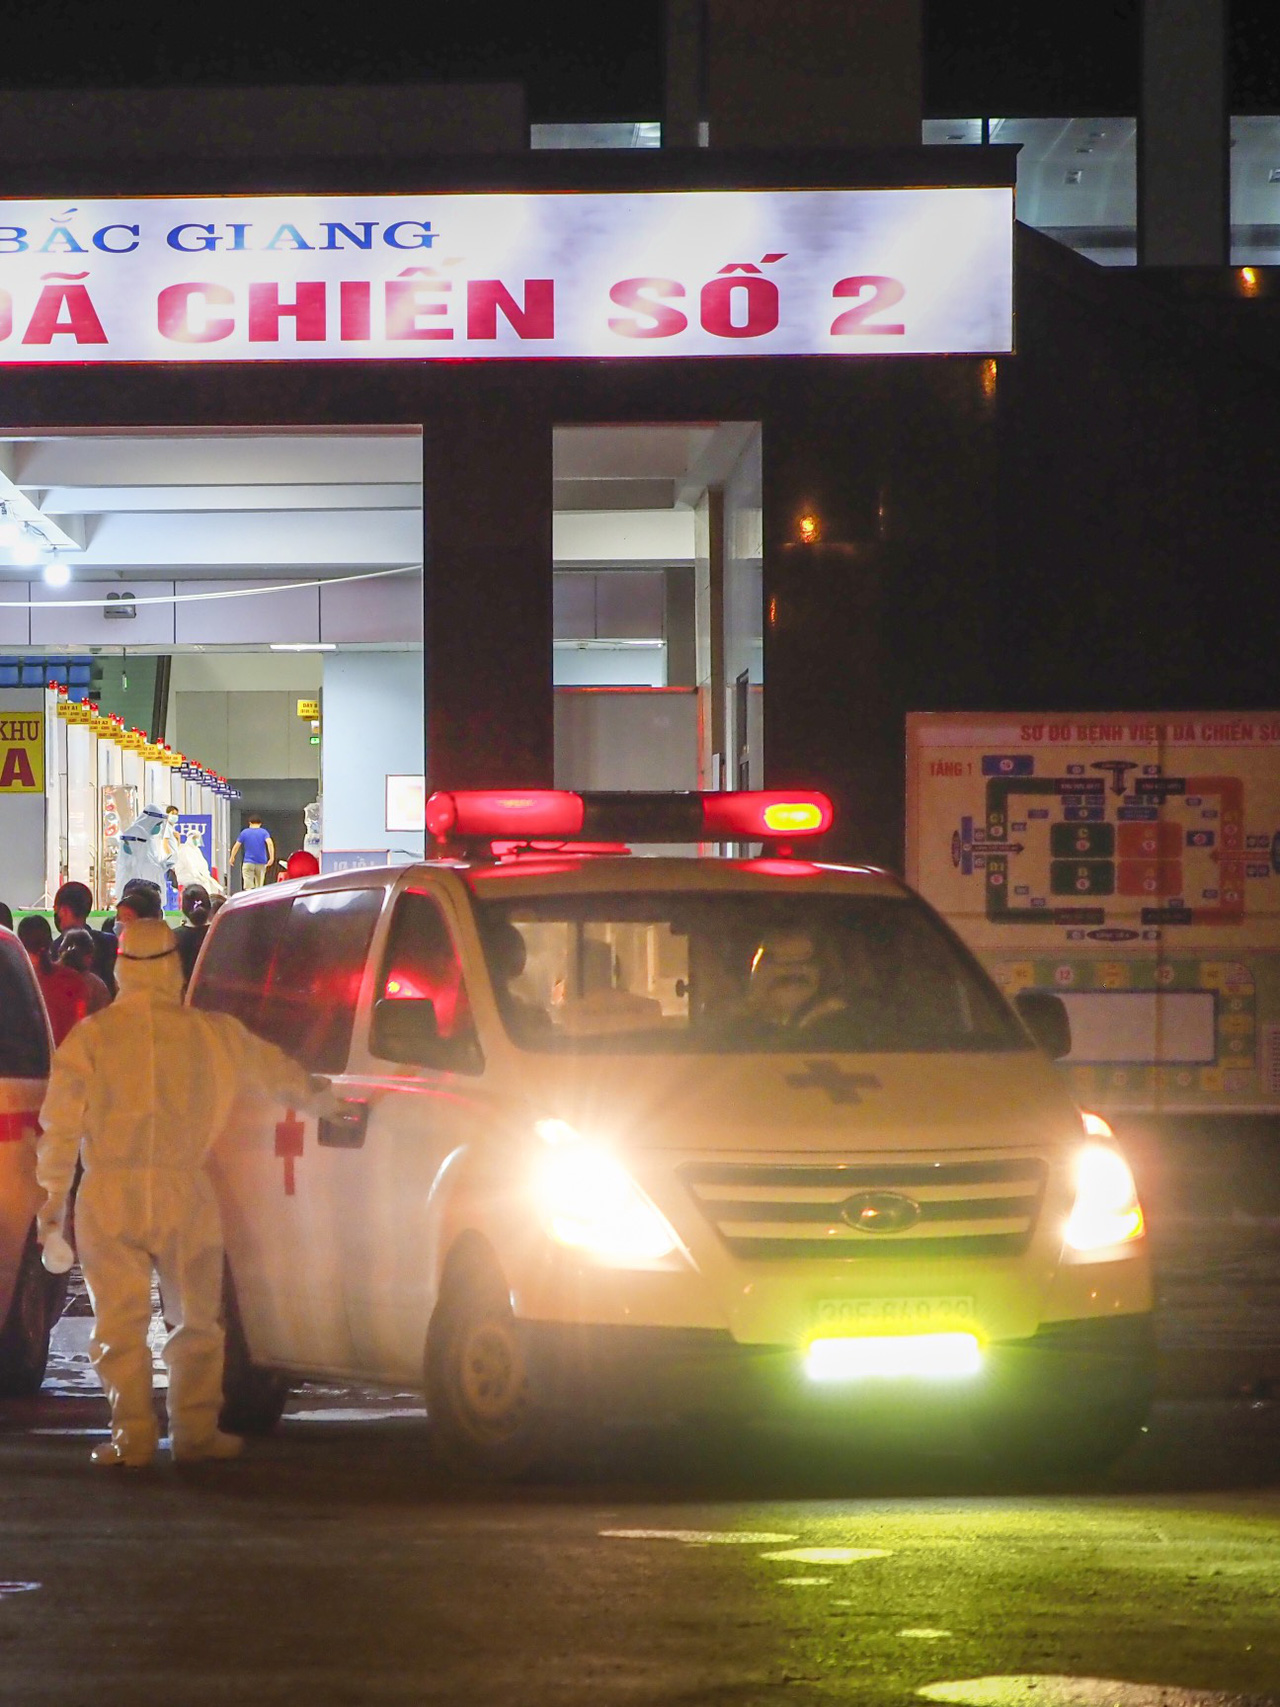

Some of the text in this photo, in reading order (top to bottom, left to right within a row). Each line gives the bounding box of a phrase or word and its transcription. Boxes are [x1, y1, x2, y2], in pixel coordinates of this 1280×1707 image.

[166, 220, 441, 253] GIANG
[157, 256, 555, 344] CHIẾN
[606, 252, 790, 339] SỐ
[829, 275, 907, 336] 2
